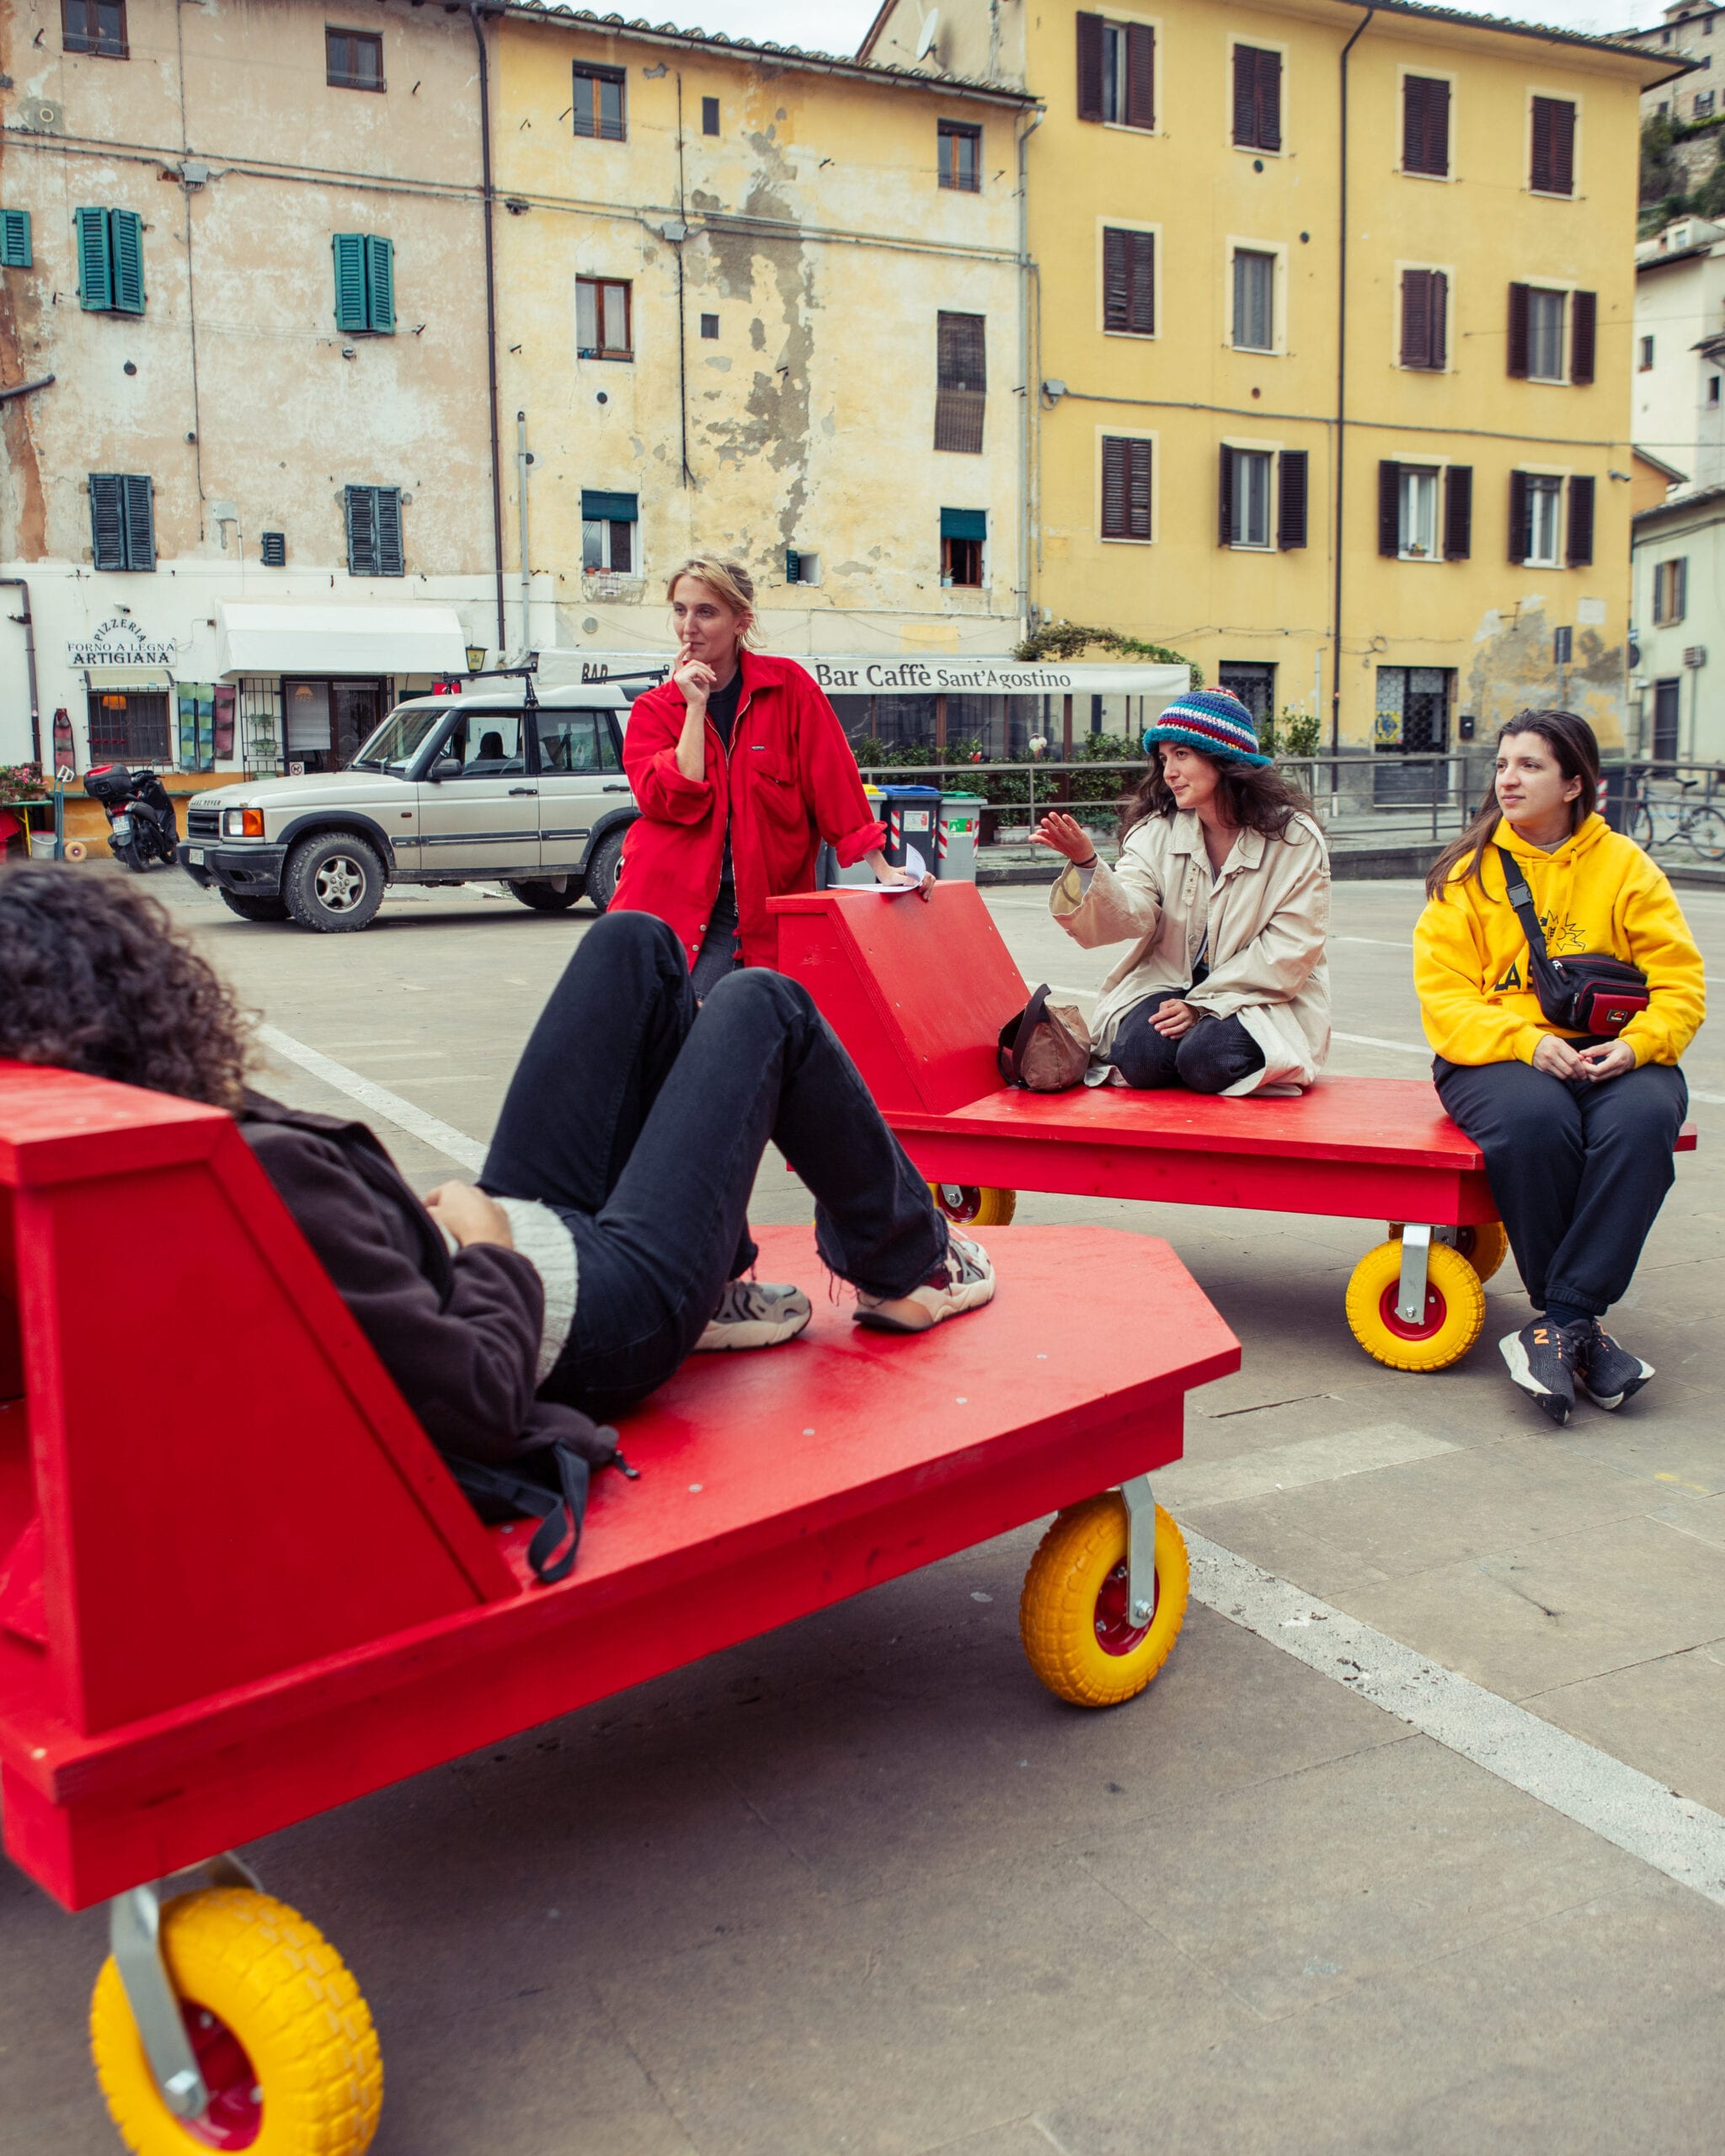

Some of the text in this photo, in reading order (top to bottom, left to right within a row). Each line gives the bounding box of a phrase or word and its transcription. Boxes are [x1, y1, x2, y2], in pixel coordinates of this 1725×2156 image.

[93, 618, 147, 643] PIZZERIA
[67, 643, 111, 652] FORNO
[131, 643, 175, 652] LEGNA
[73, 653, 169, 664] ARTIGIANA
[814, 664, 1071, 689] Bar Caffè Sant'Agostino
